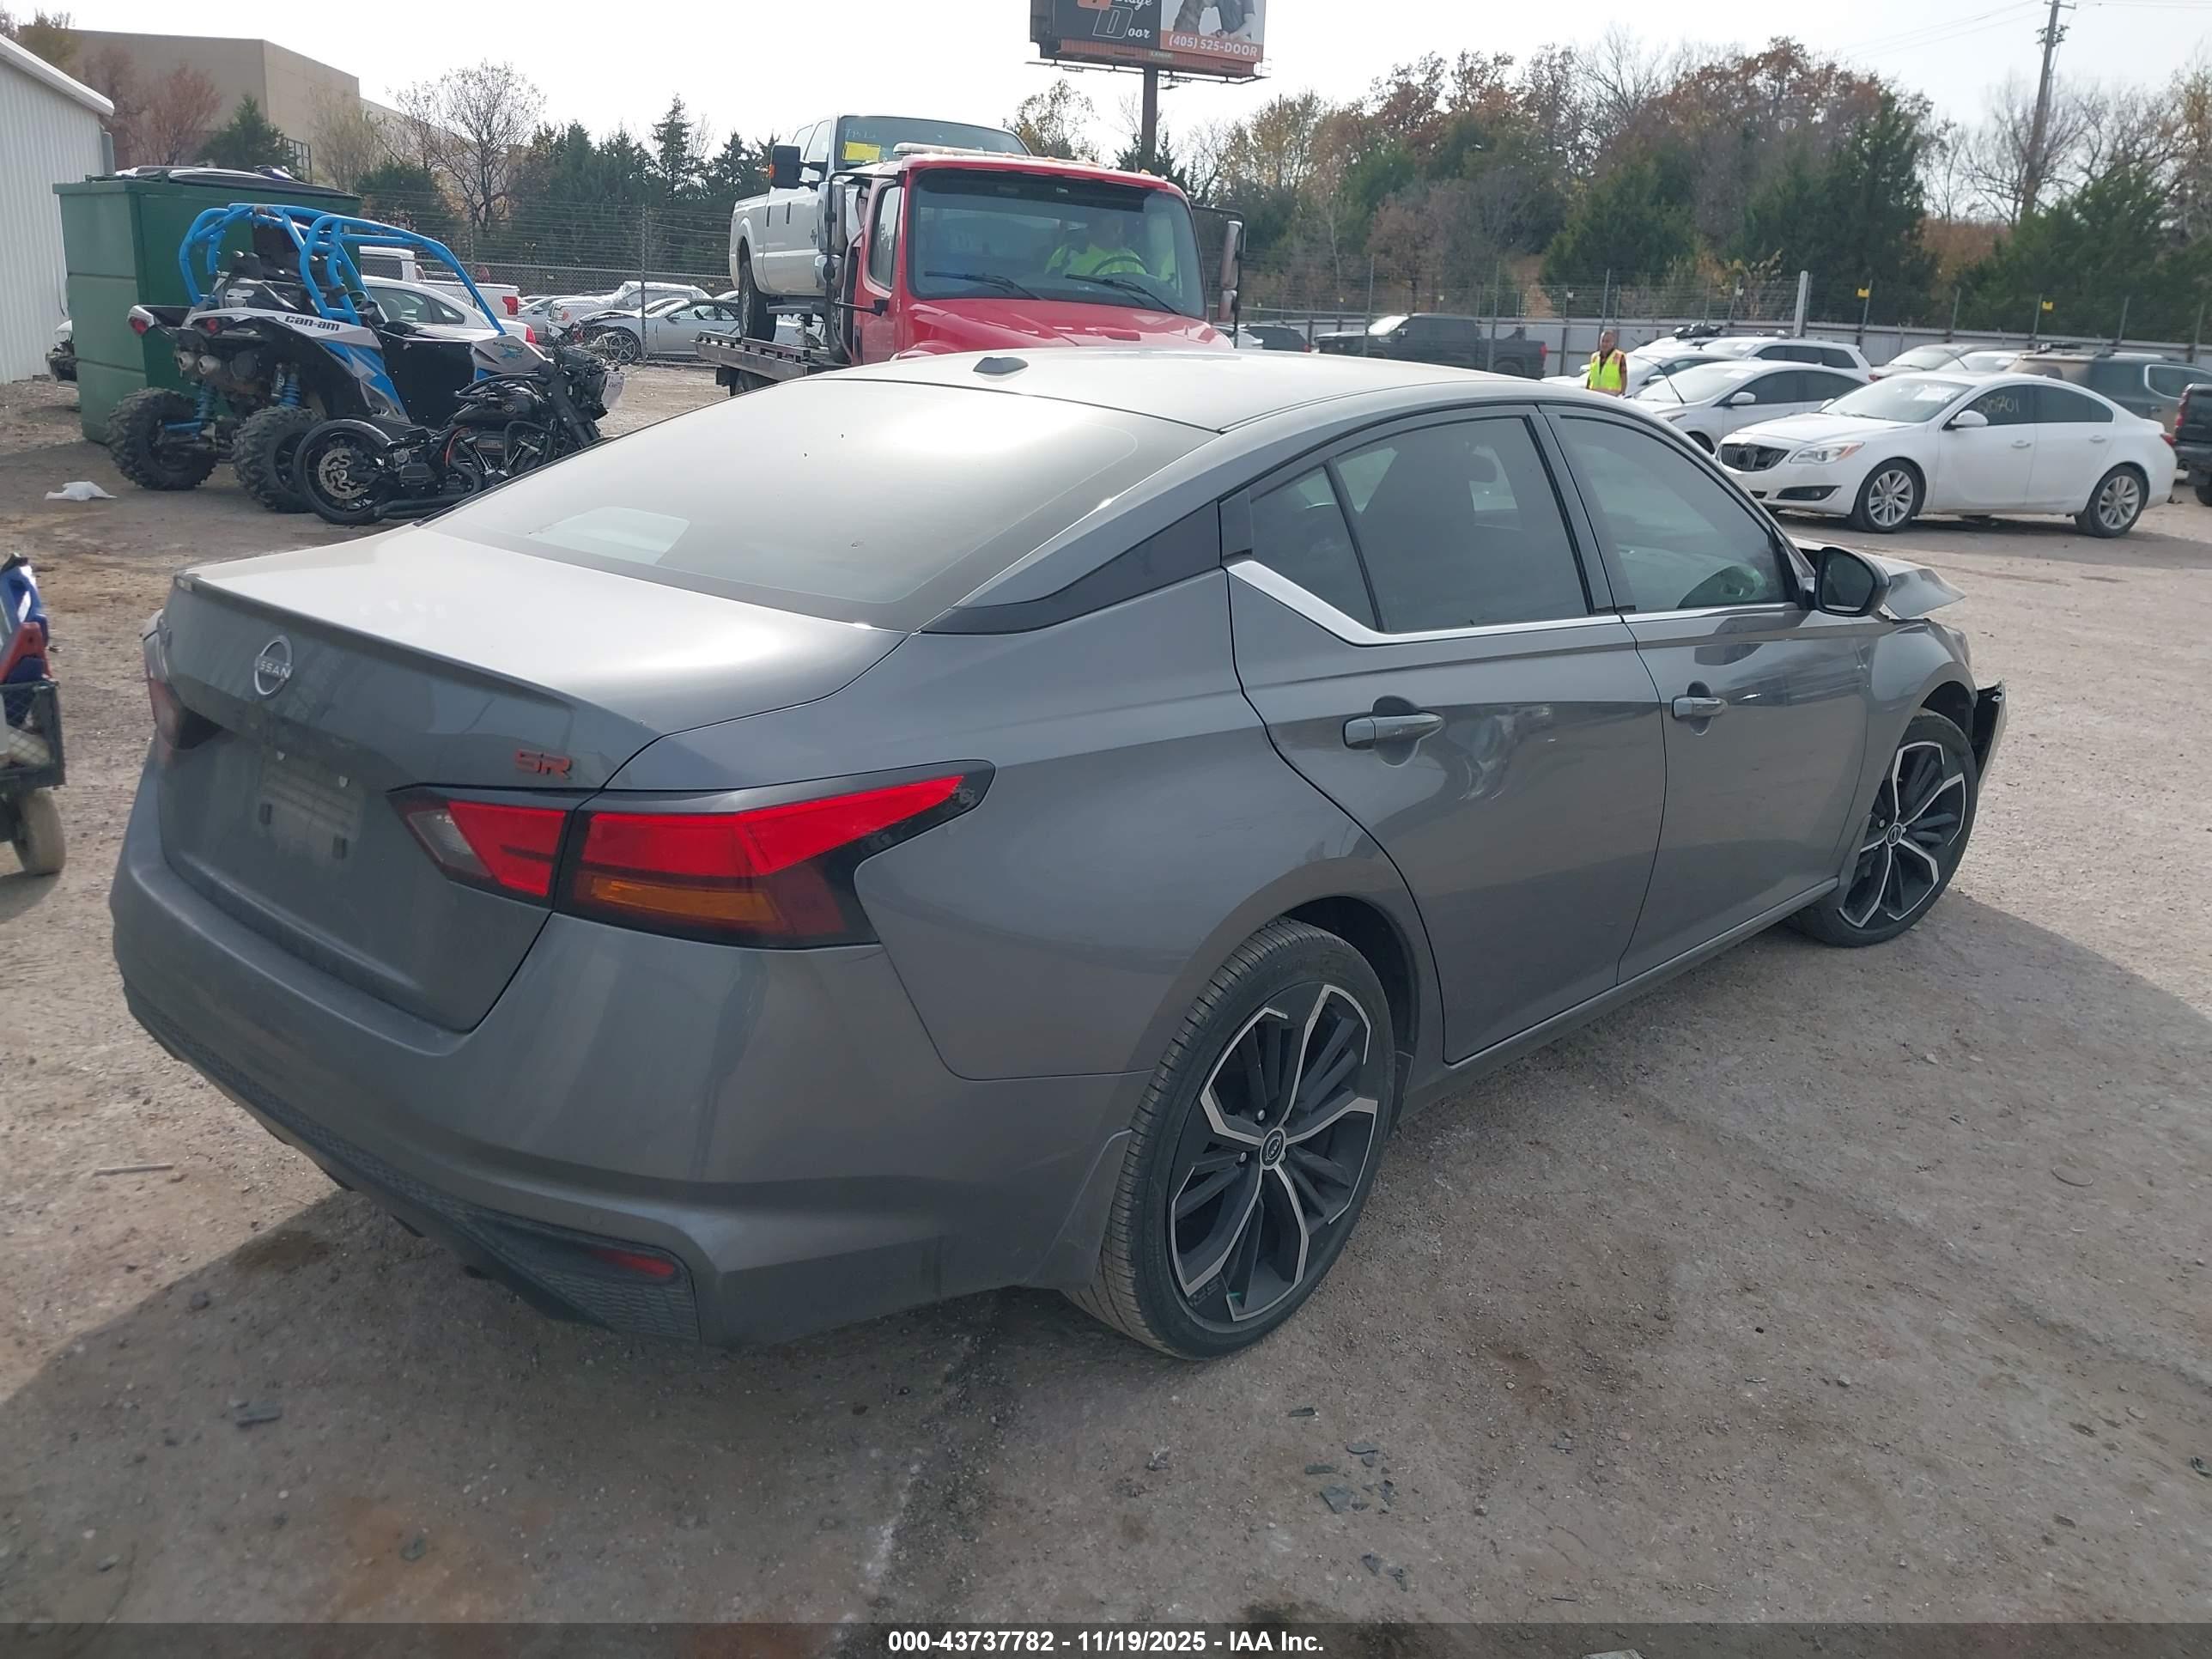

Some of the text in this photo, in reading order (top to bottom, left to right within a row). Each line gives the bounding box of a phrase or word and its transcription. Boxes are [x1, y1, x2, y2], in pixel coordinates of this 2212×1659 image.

[1092, 5, 1151, 40] Door
[1169, 34, 1258, 58] (405) 525-DOOR
[284, 315, 340, 331] can-am
[258, 658, 292, 679] SSAN
[514, 749, 571, 779] SR
